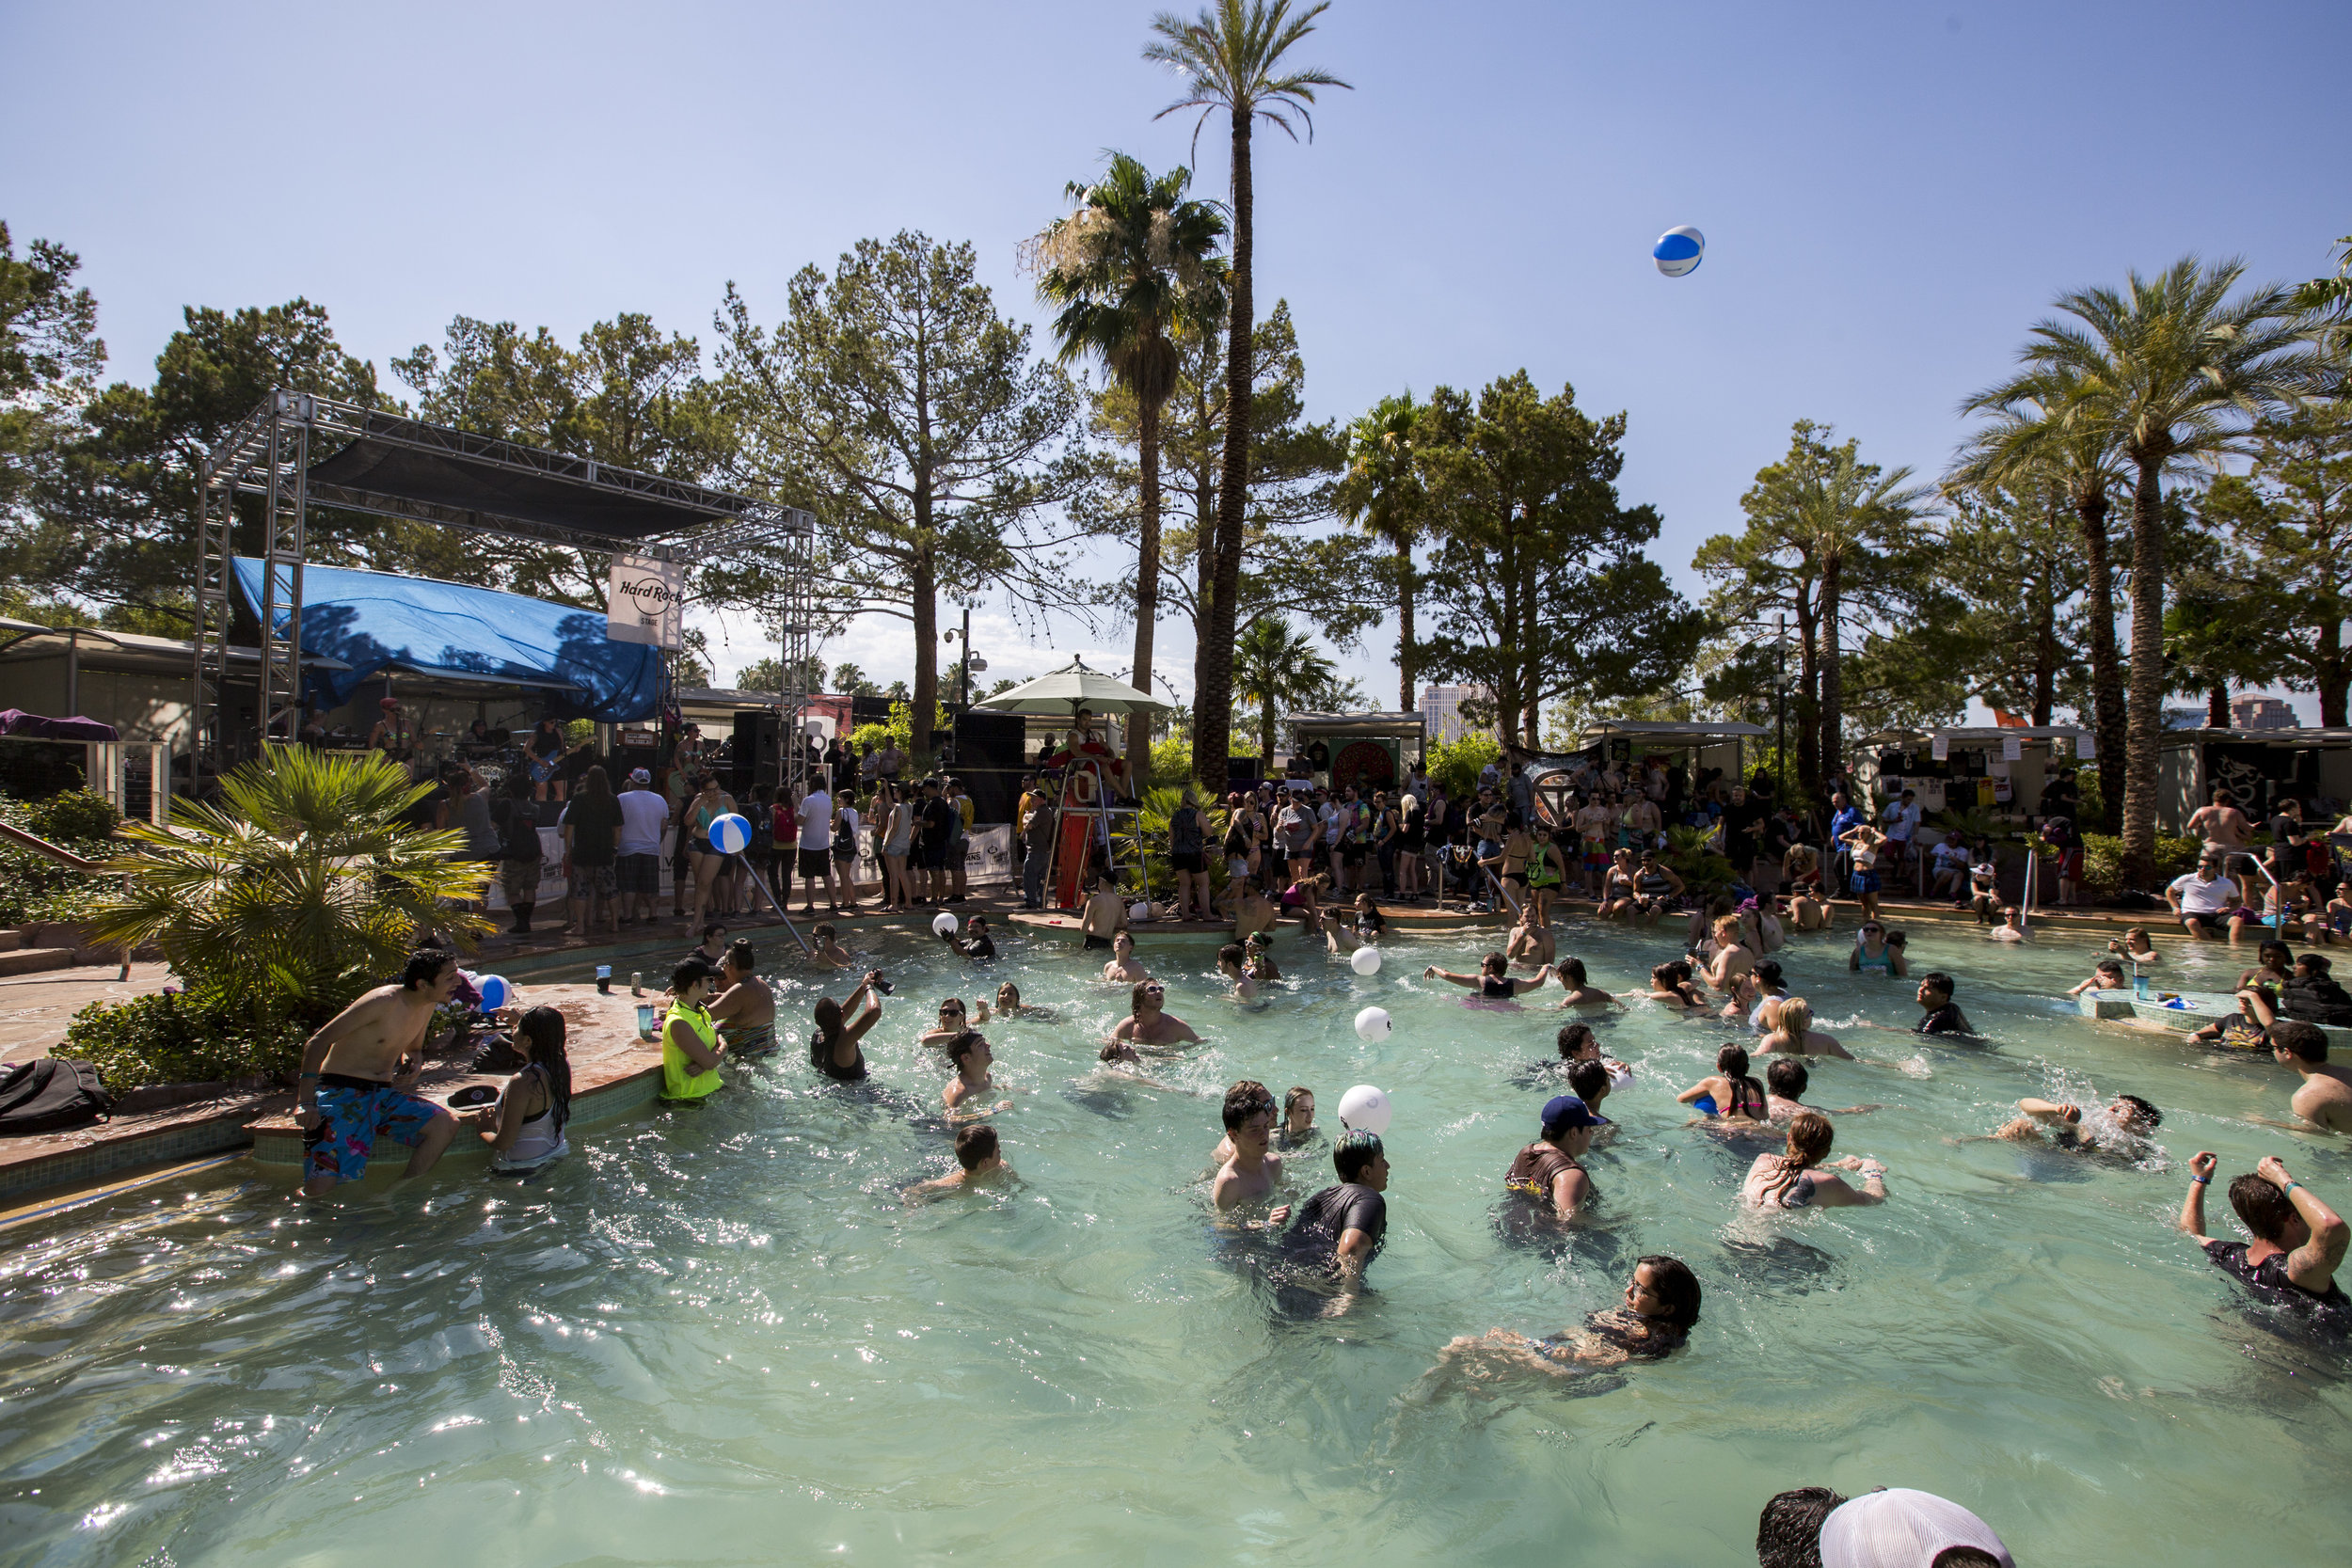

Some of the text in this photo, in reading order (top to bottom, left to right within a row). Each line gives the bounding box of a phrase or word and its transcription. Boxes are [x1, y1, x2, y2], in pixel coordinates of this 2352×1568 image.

[619, 581, 682, 606] Hard Rock
[640, 617, 659, 626] STAGE
[965, 851, 981, 861] ANS
